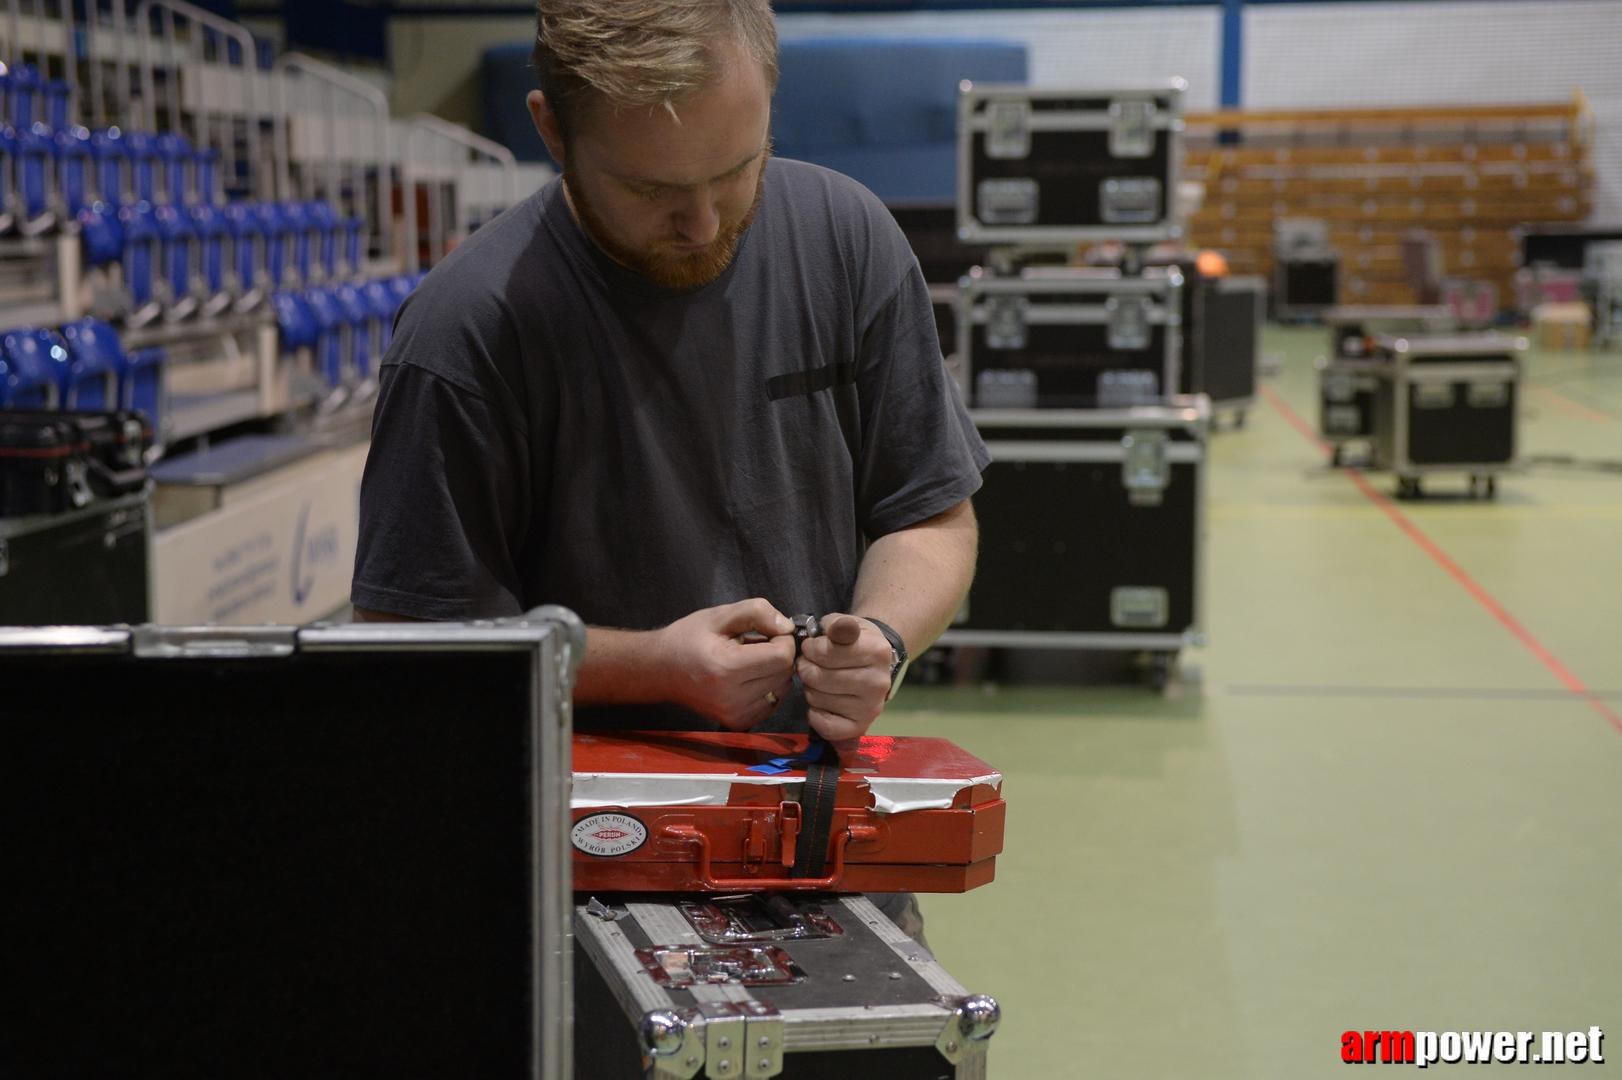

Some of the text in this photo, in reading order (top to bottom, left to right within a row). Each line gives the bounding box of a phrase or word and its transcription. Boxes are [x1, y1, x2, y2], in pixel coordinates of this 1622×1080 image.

[577, 817, 599, 833] MADE
[612, 816, 642, 834] POLAND
[611, 837, 640, 853] POLSKI
